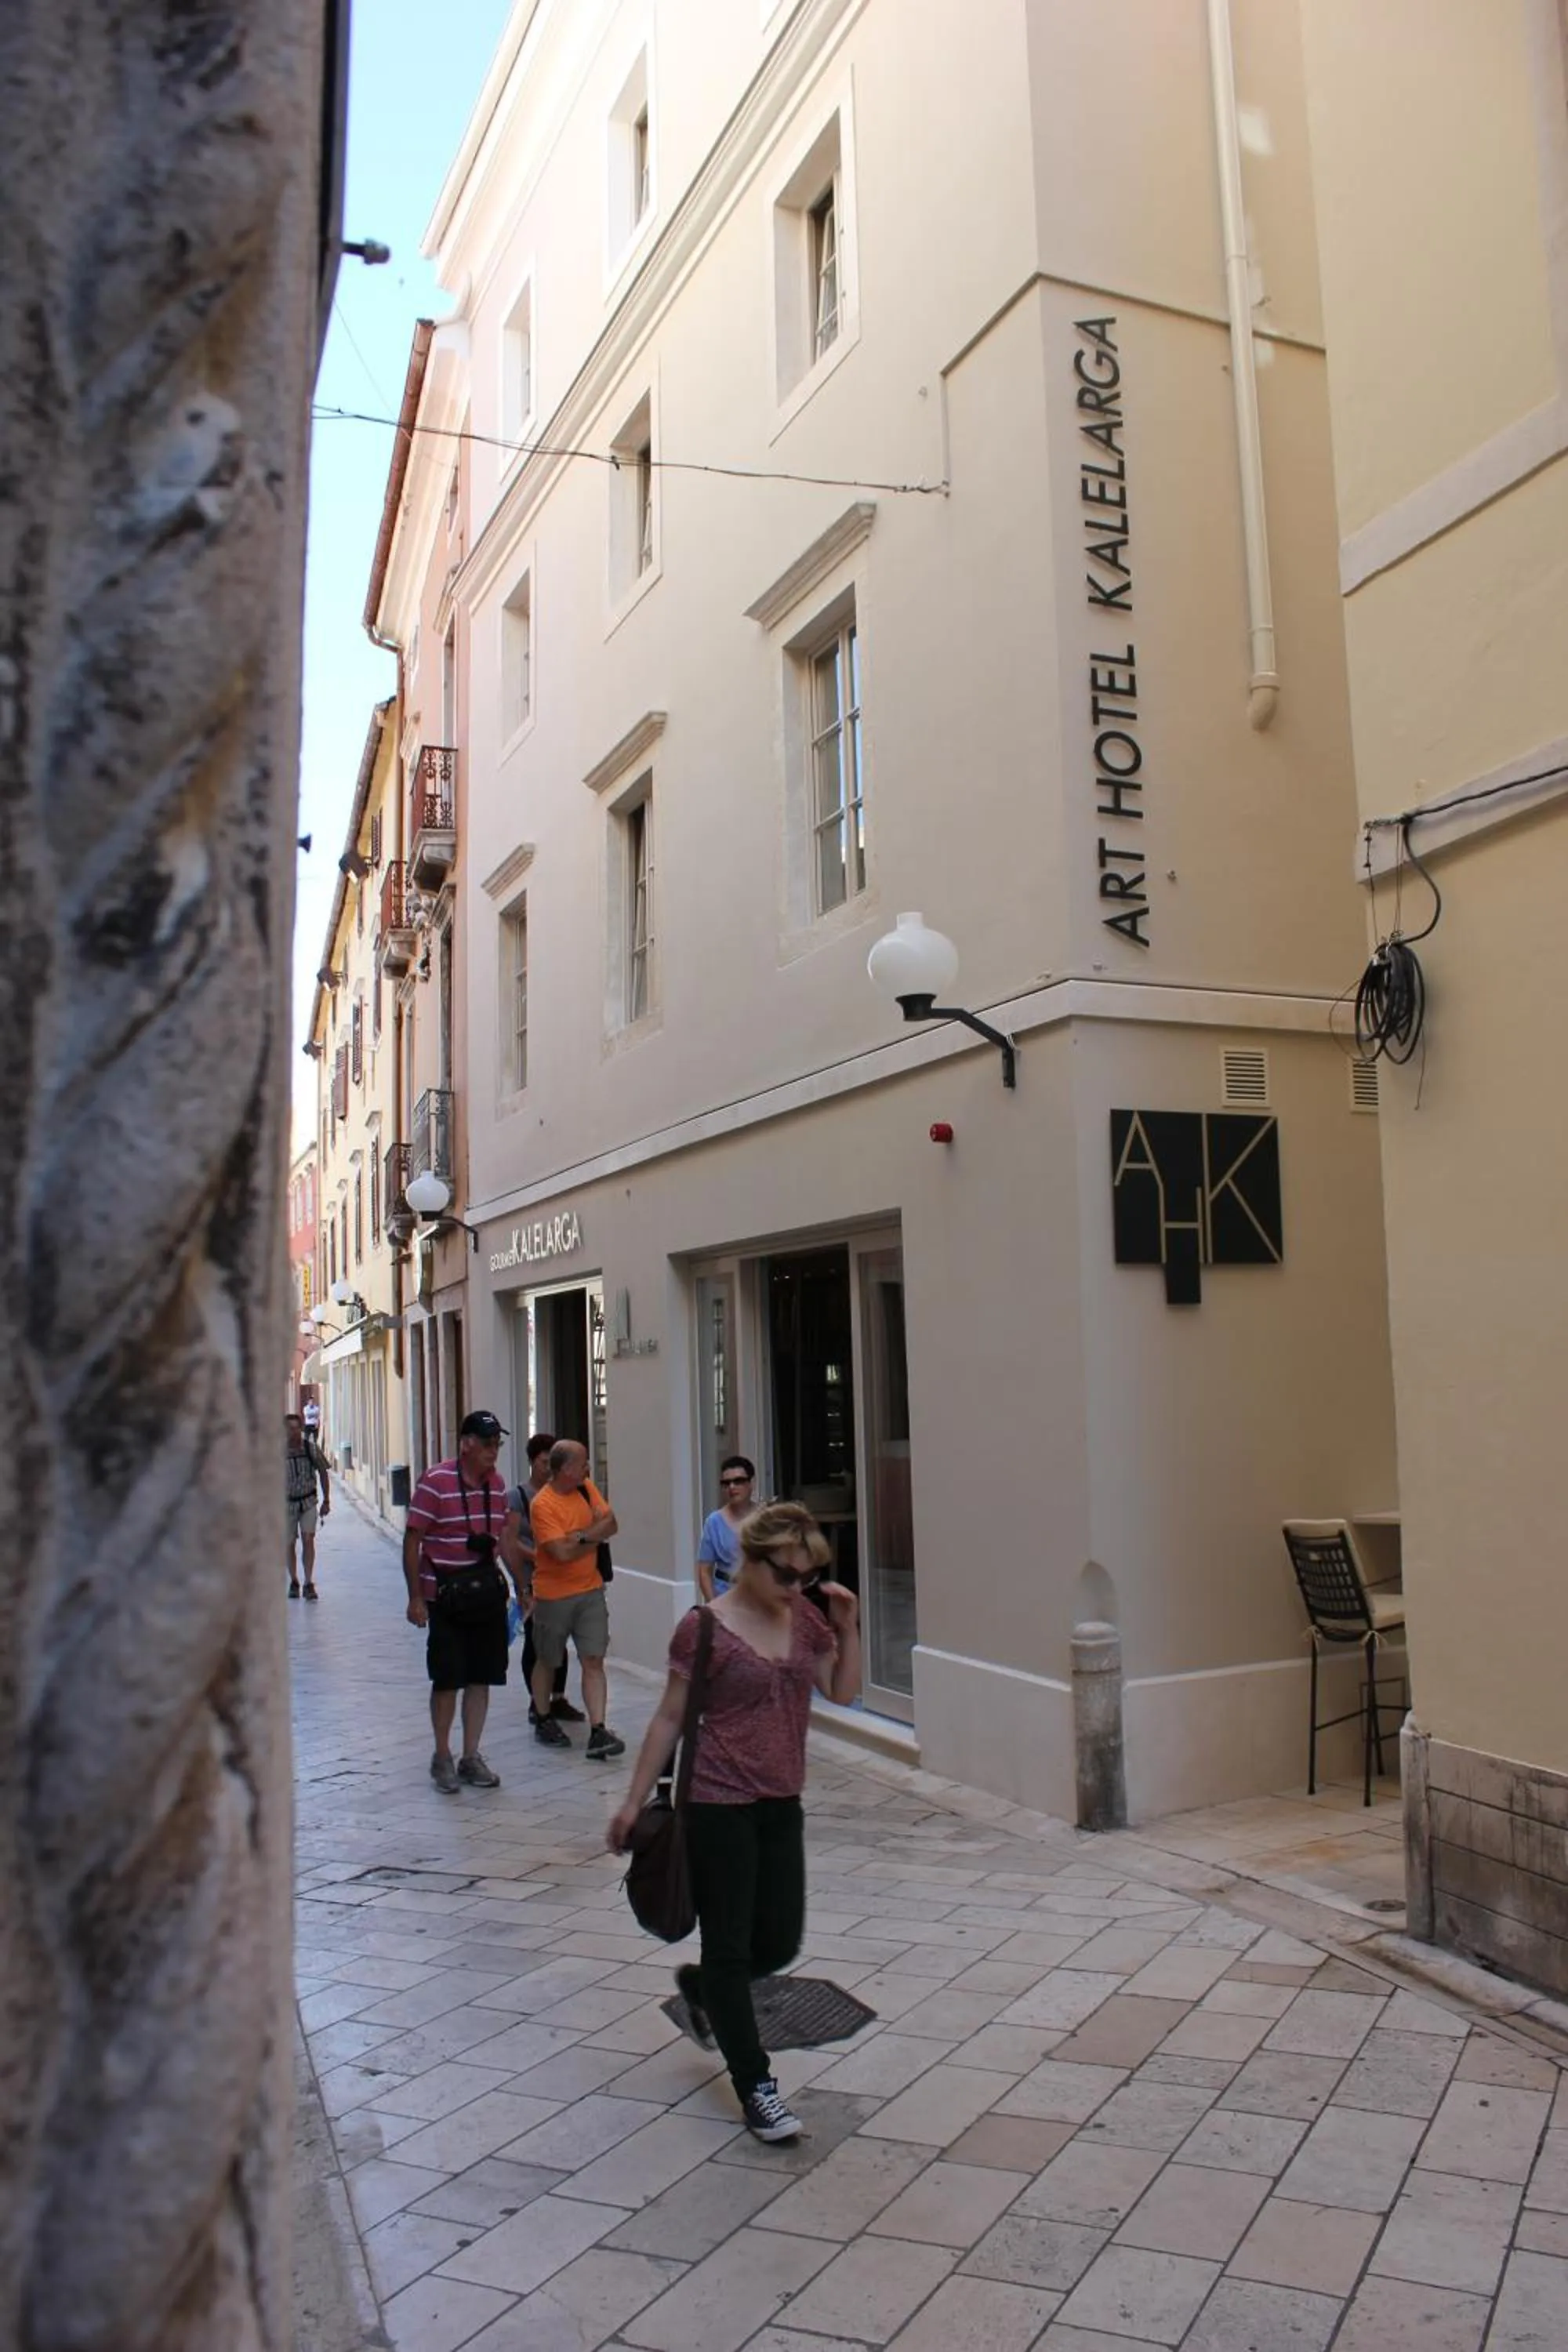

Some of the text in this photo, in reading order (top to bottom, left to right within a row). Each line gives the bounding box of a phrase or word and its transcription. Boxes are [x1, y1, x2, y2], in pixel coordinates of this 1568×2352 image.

[1073, 317, 1150, 949] ART HOTEL KALELARGA
[511, 1211, 583, 1265] KALELARGA
